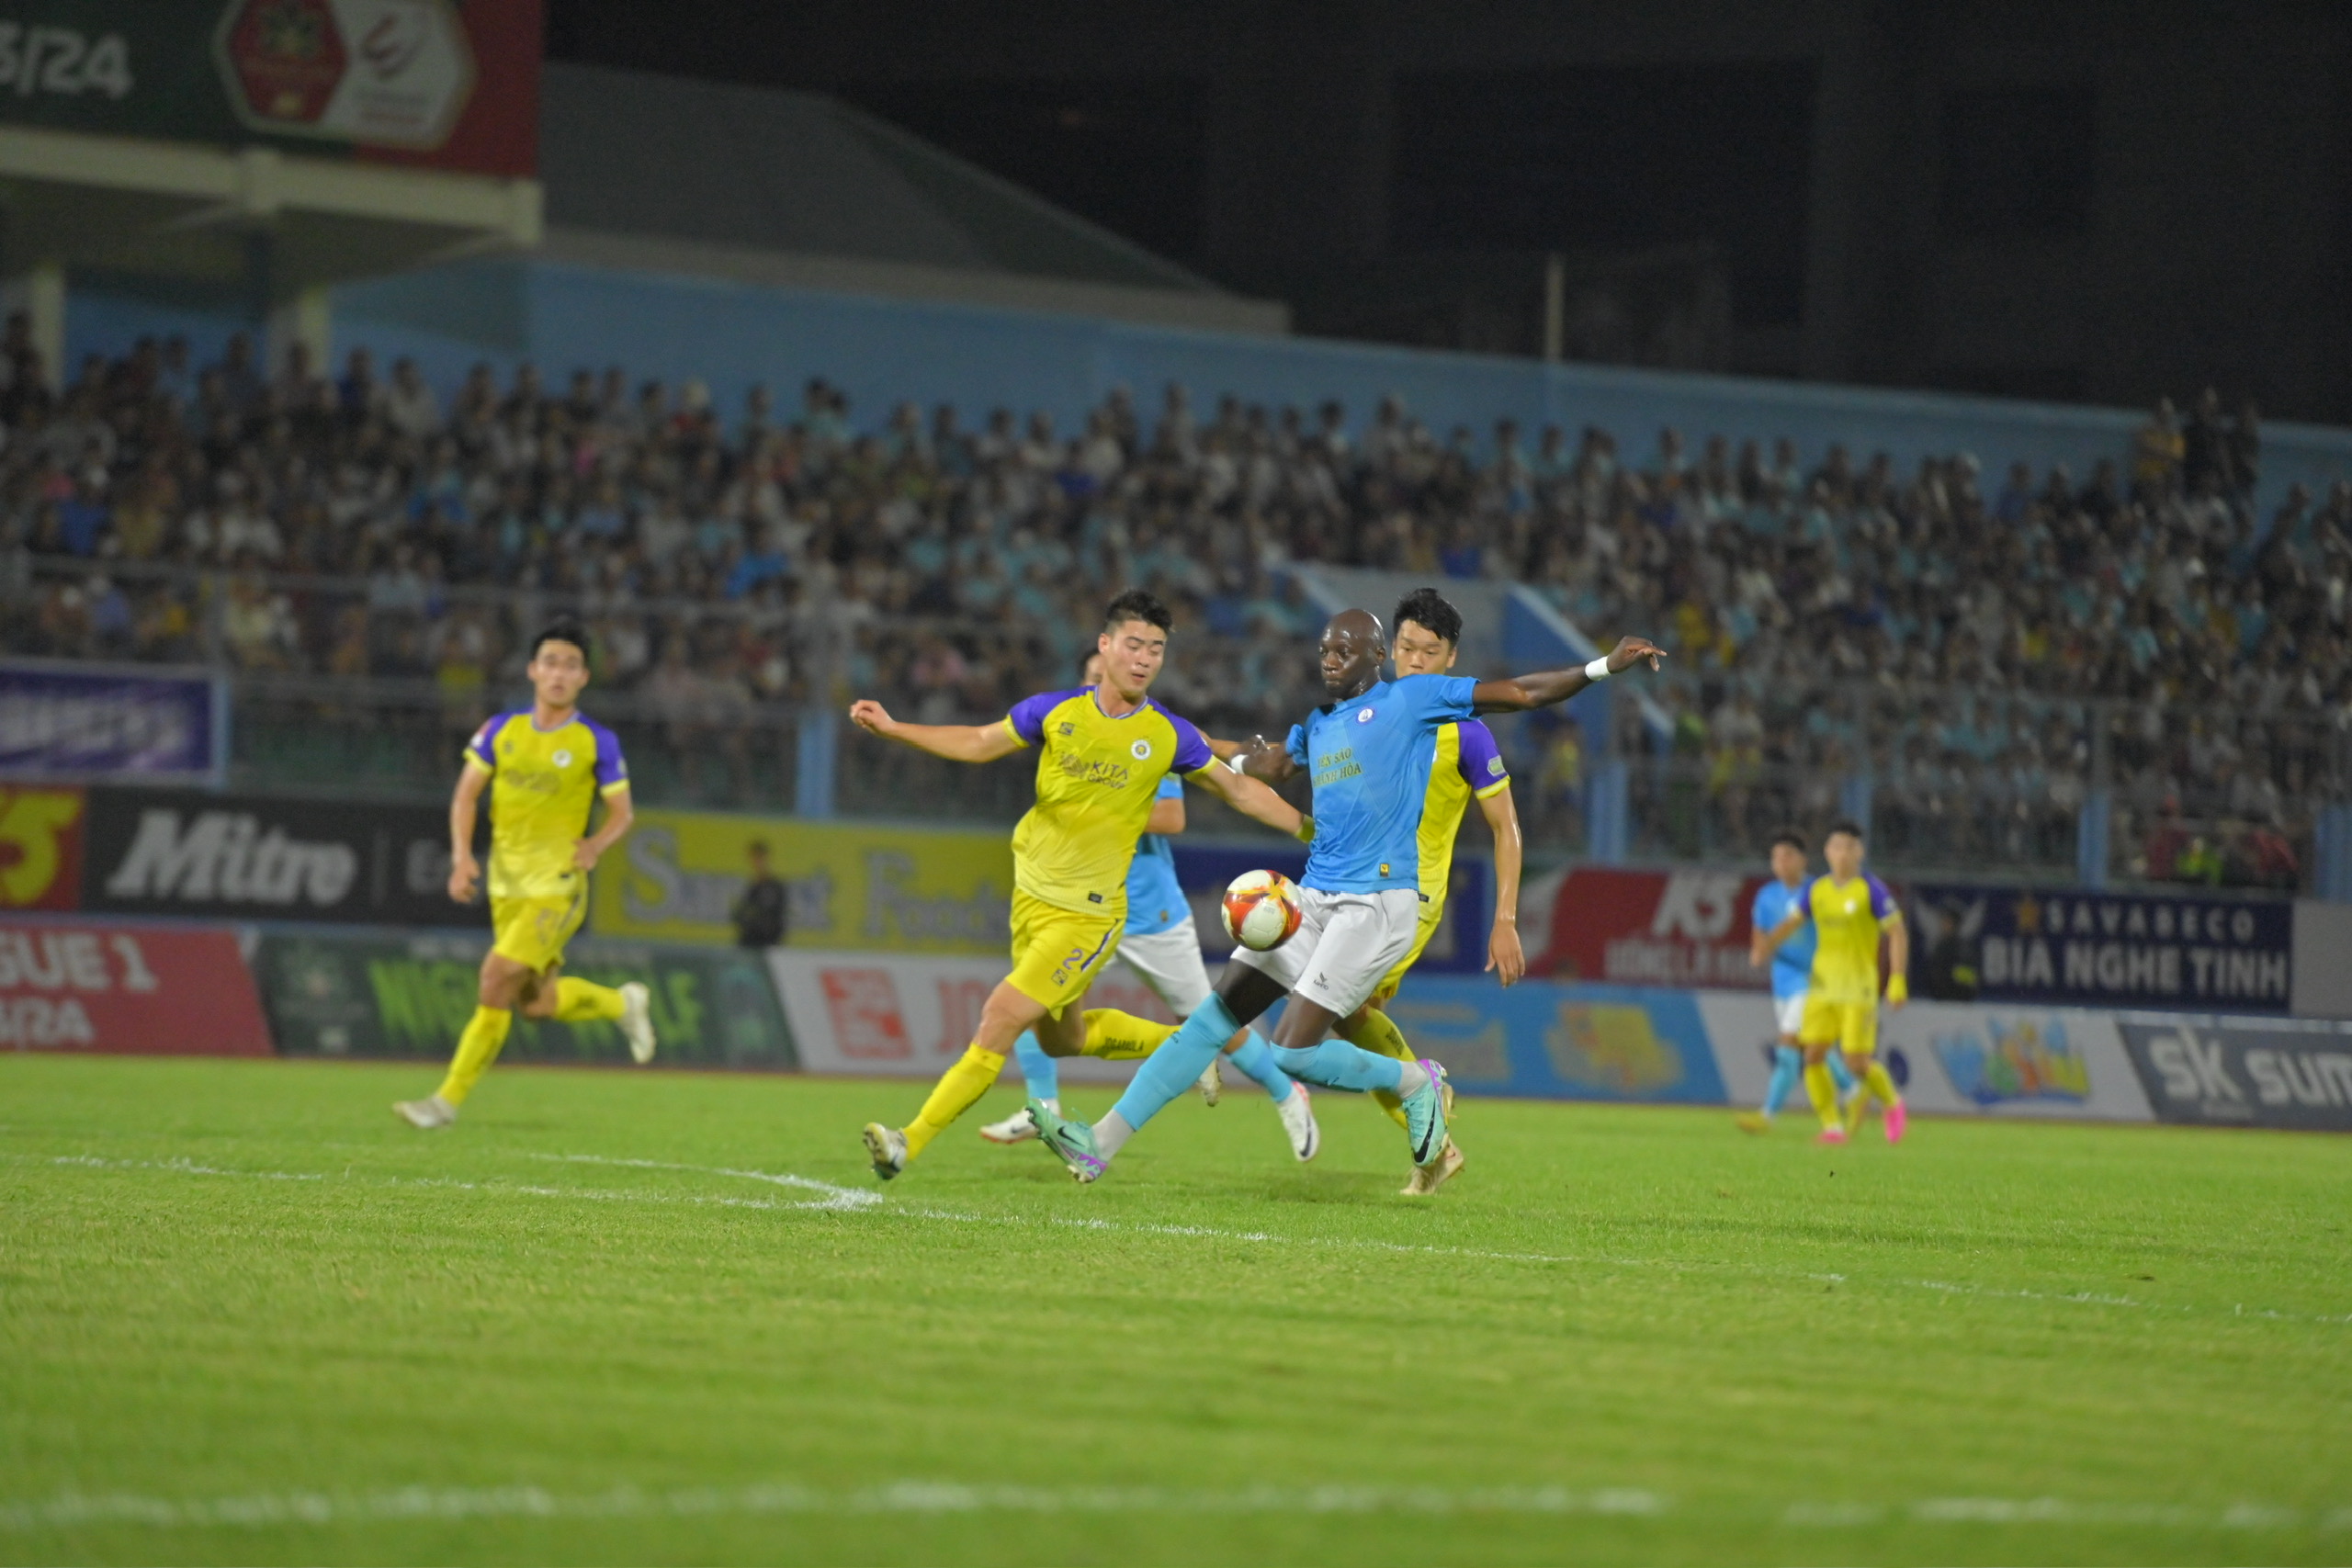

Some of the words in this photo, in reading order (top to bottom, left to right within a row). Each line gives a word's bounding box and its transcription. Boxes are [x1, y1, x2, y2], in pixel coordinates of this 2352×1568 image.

[112, 933, 160, 993] 1
[1062, 947, 1083, 971] 2
[1983, 936, 2055, 987] BIA
[2188, 947, 2288, 1000] TINH
